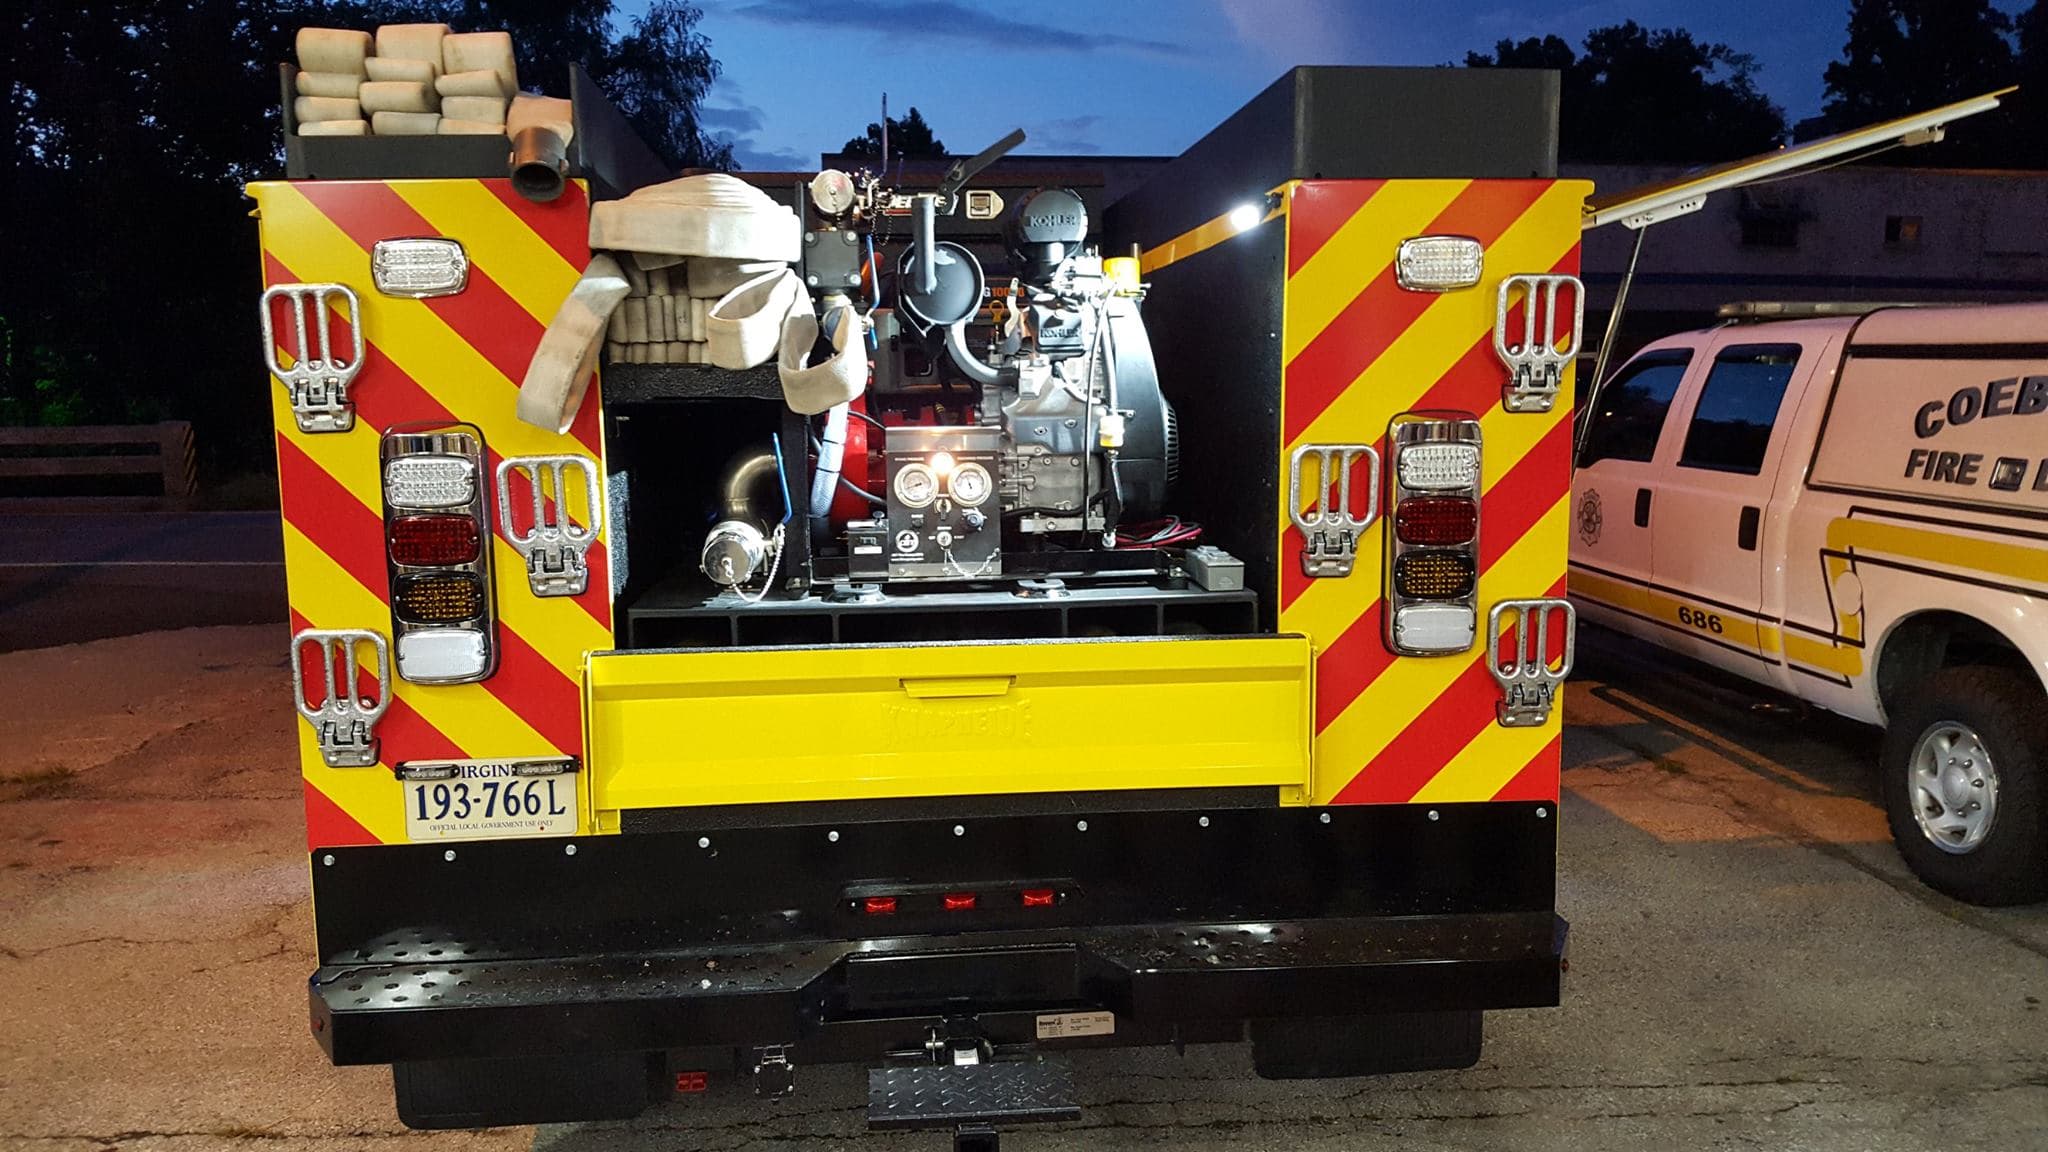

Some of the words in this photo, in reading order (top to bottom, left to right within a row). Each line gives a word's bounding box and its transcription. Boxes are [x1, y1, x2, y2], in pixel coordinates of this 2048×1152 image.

[1030, 214, 1077, 228] KOHLER
[1914, 375, 2048, 439] COEB
[1904, 448, 1984, 486] FIRE
[1678, 606, 1723, 634] 686
[460, 764, 514, 778] IRGIN
[415, 780, 566, 820] 193-766L
[429, 823, 457, 831] OFFICIAL
[481, 820, 523, 830] GOVERNMENT
